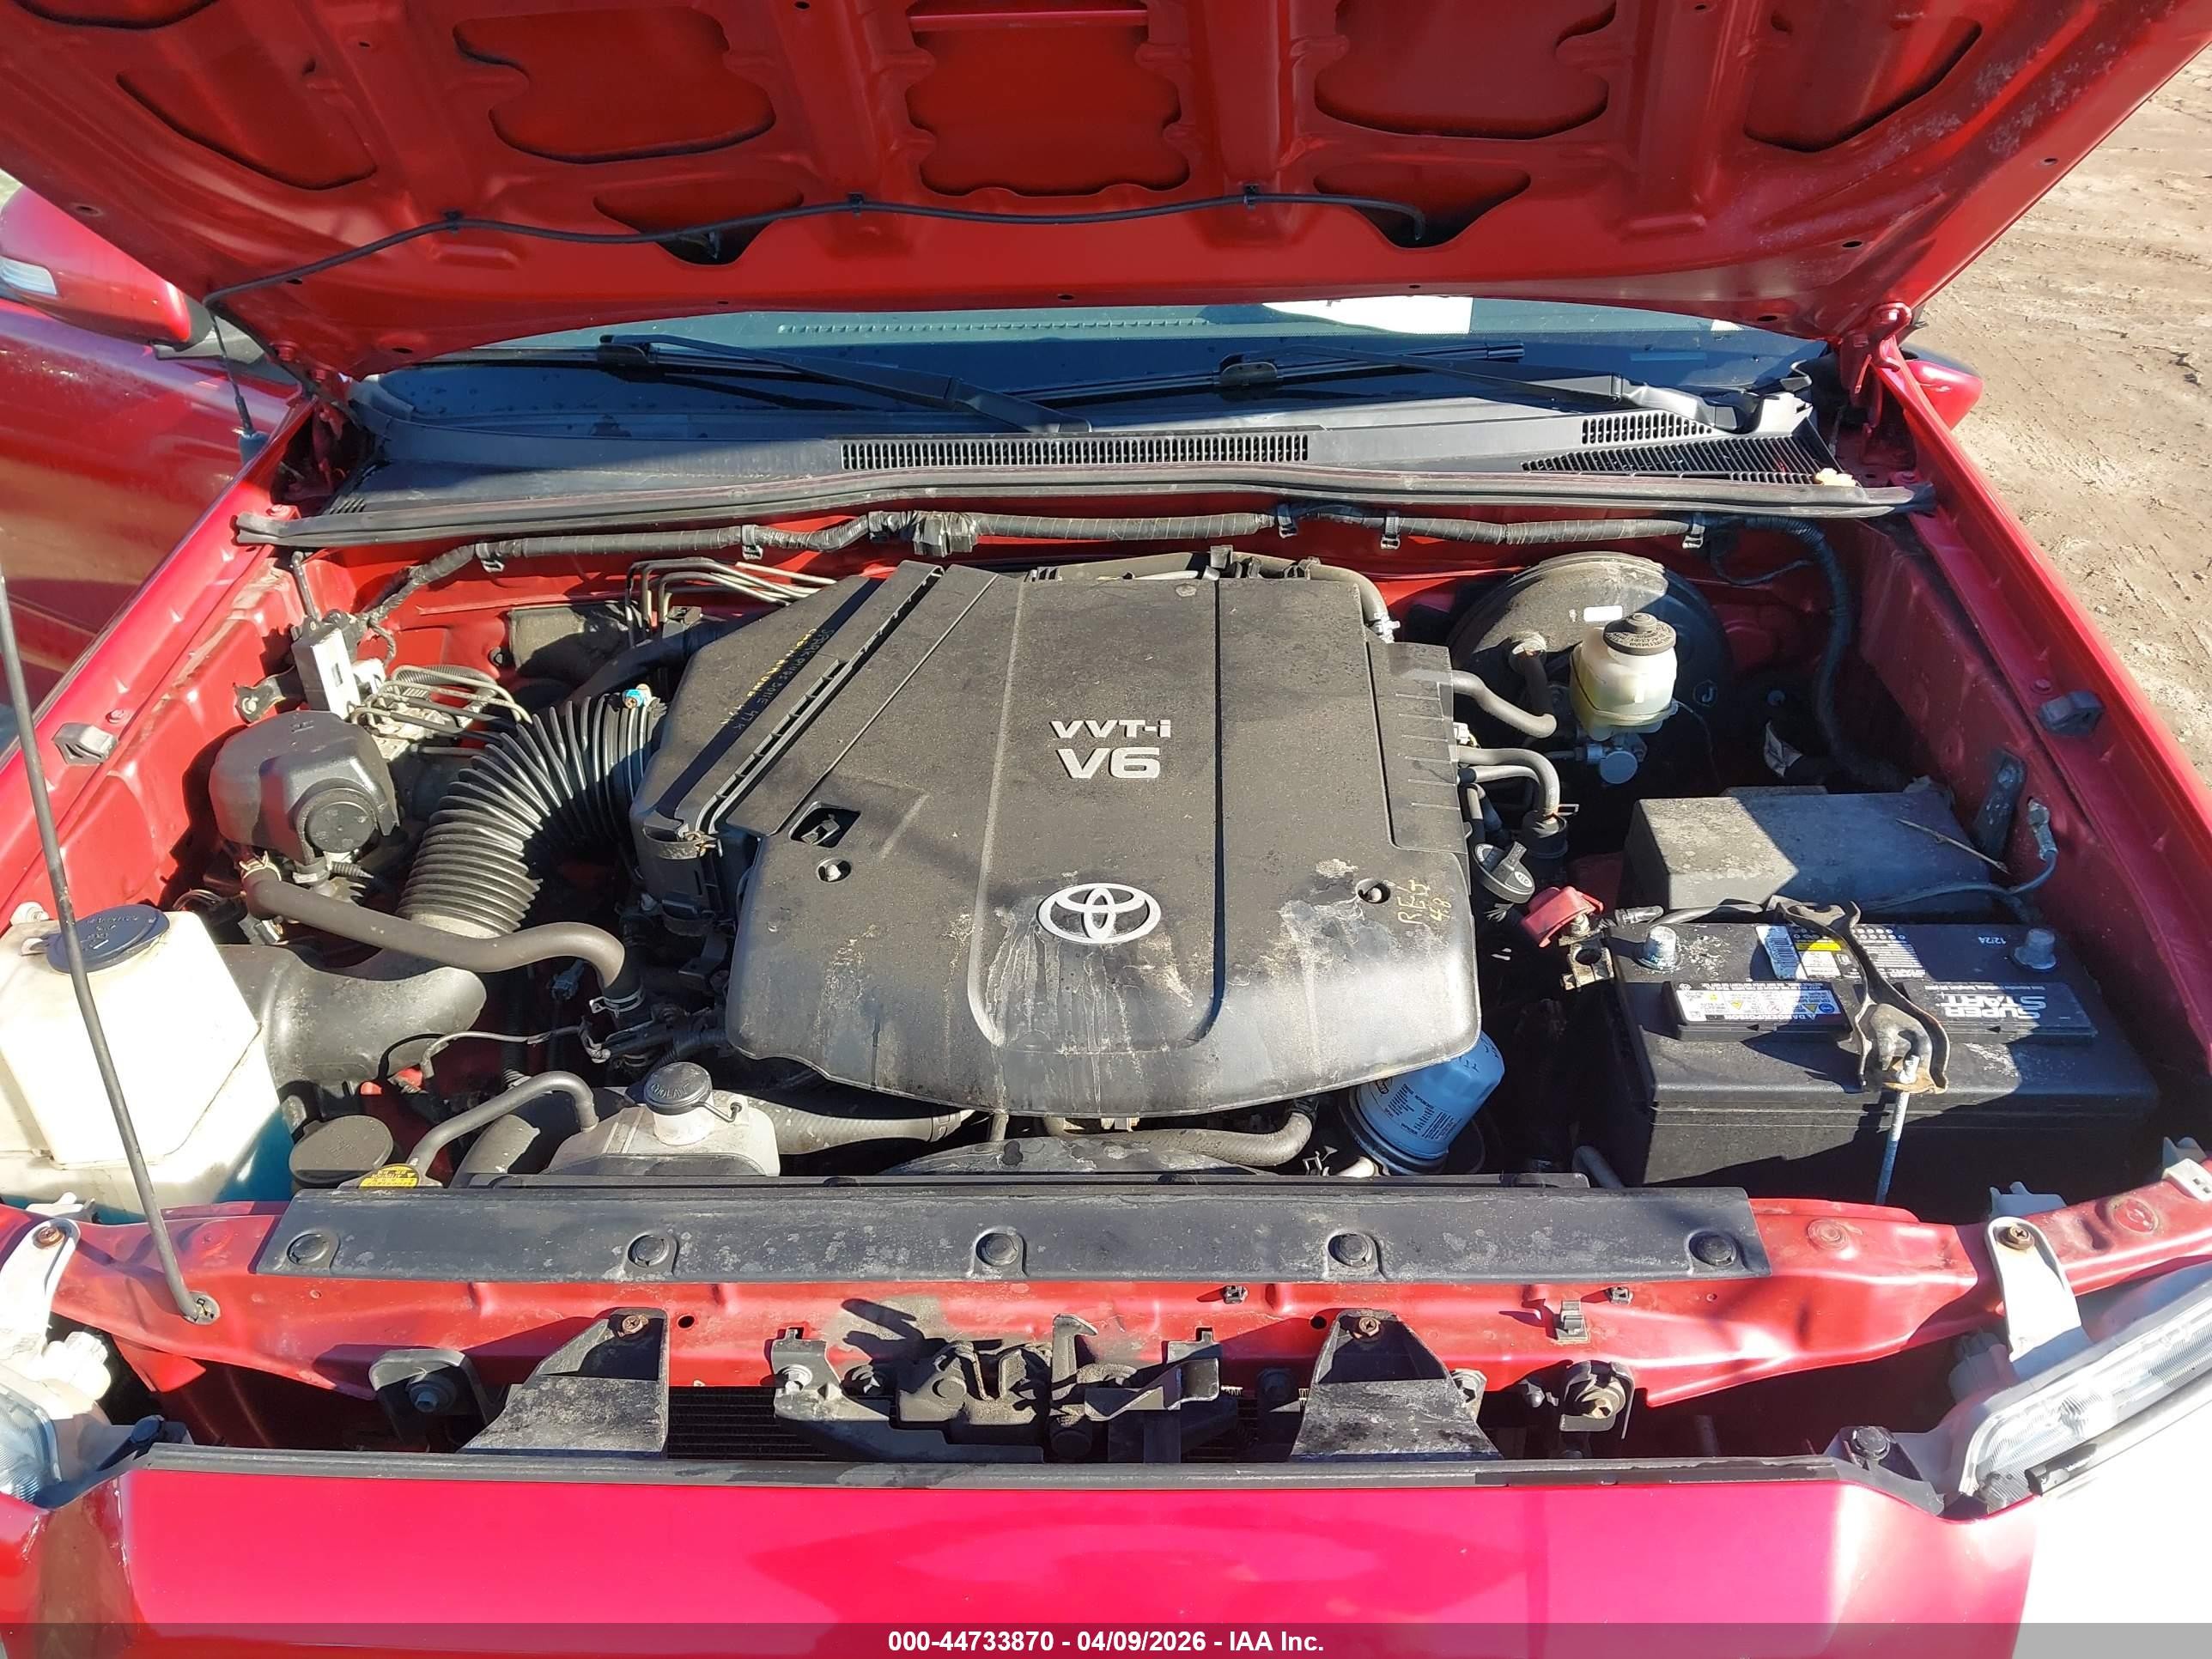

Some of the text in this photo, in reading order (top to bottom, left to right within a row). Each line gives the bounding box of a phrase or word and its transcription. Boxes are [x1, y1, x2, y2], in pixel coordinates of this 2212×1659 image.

[756, 681, 783, 705] DONE
[1048, 720, 1171, 738] VVT-i
[1056, 746, 1160, 779] V6
[1938, 995, 2046, 1008] START
[1944, 1006, 2041, 1019] SUPER
